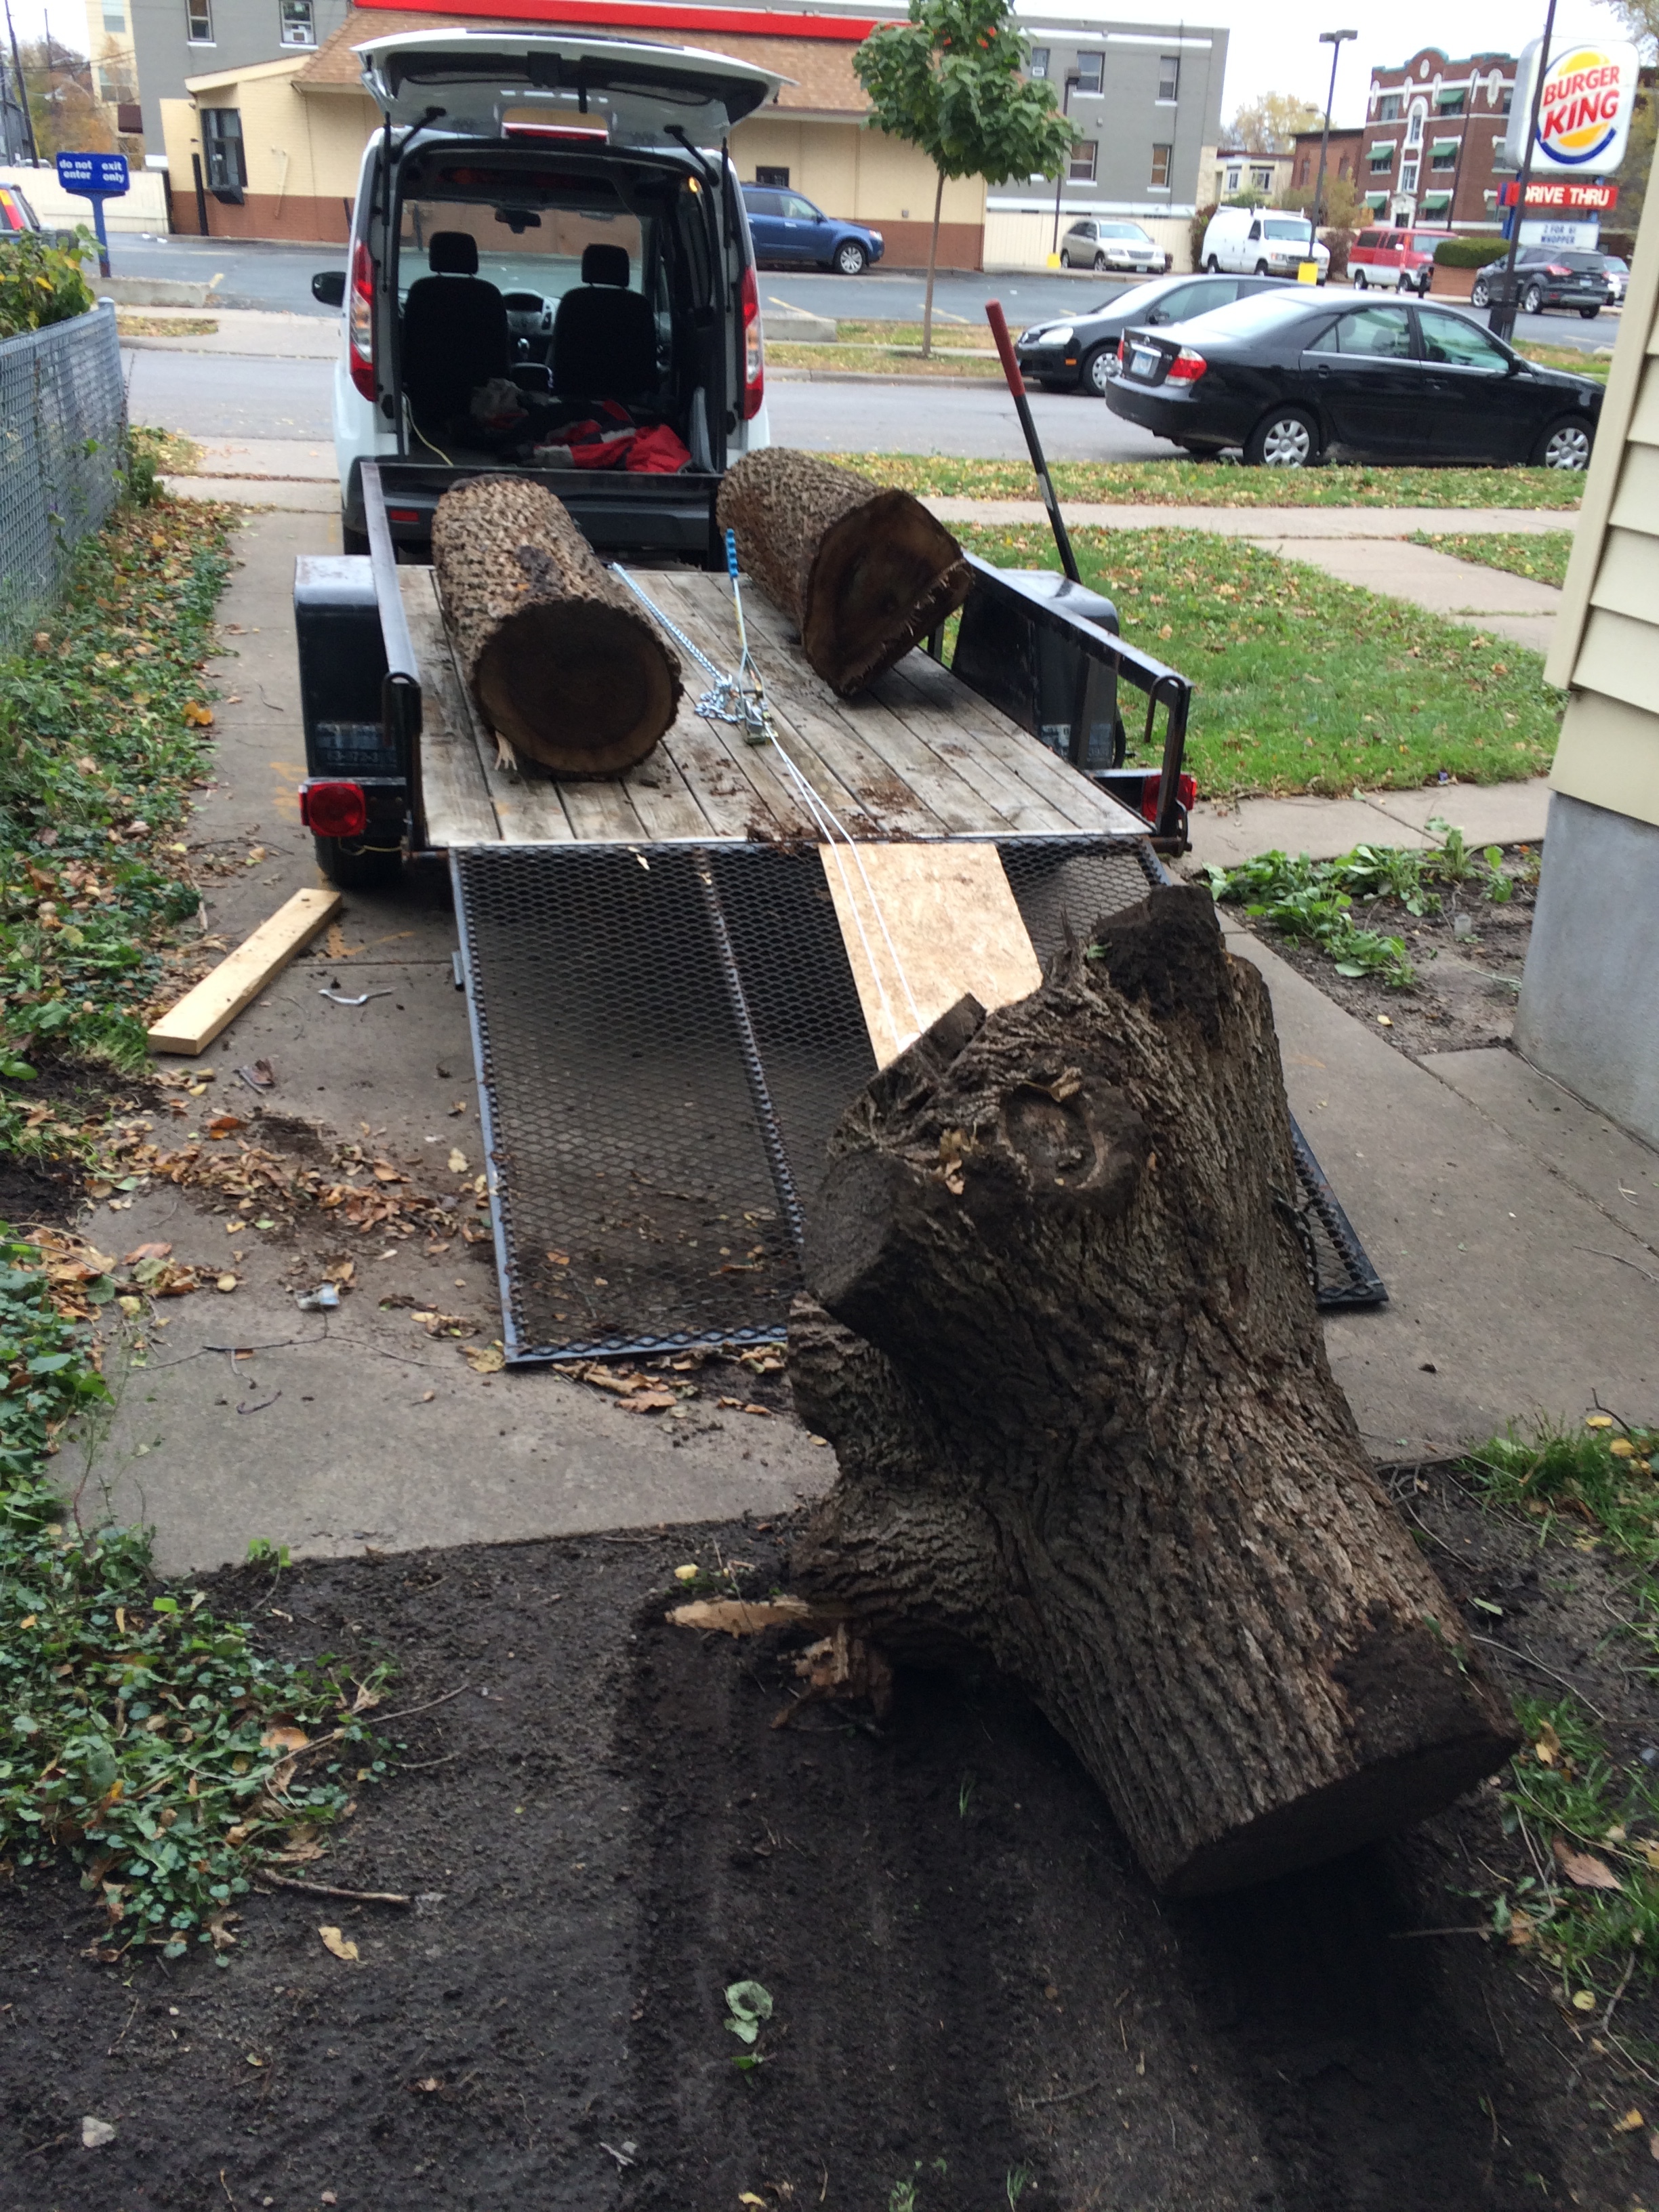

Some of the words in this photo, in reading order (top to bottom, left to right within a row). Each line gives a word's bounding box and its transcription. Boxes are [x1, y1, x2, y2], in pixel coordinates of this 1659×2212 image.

[1543, 66, 1620, 107] BURGER
[1542, 89, 1620, 140] KING
[59, 159, 73, 169] do
[75, 159, 92, 170] not
[101, 161, 122, 171] exit
[63, 169, 91, 180] enter
[102, 171, 125, 184] only
[1570, 187, 1610, 206] THRU
